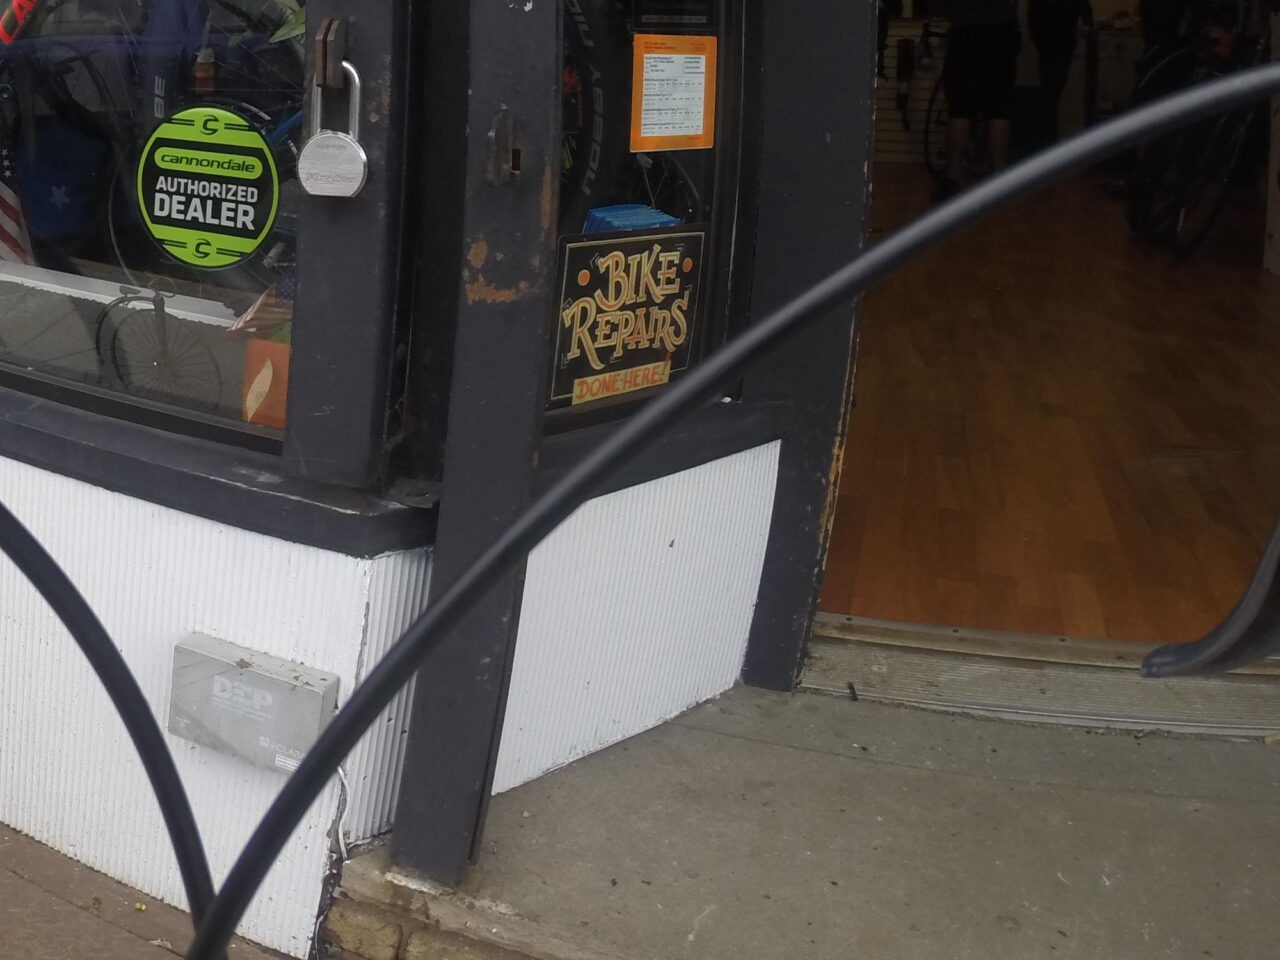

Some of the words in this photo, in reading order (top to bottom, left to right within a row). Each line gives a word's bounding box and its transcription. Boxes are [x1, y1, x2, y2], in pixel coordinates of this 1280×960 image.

[160, 153, 255, 173] cannondale
[155, 175, 259, 203] AUTHORIZED
[153, 195, 255, 230] DEALER
[595, 243, 681, 312] BIKE
[564, 289, 690, 371] REPAIRS
